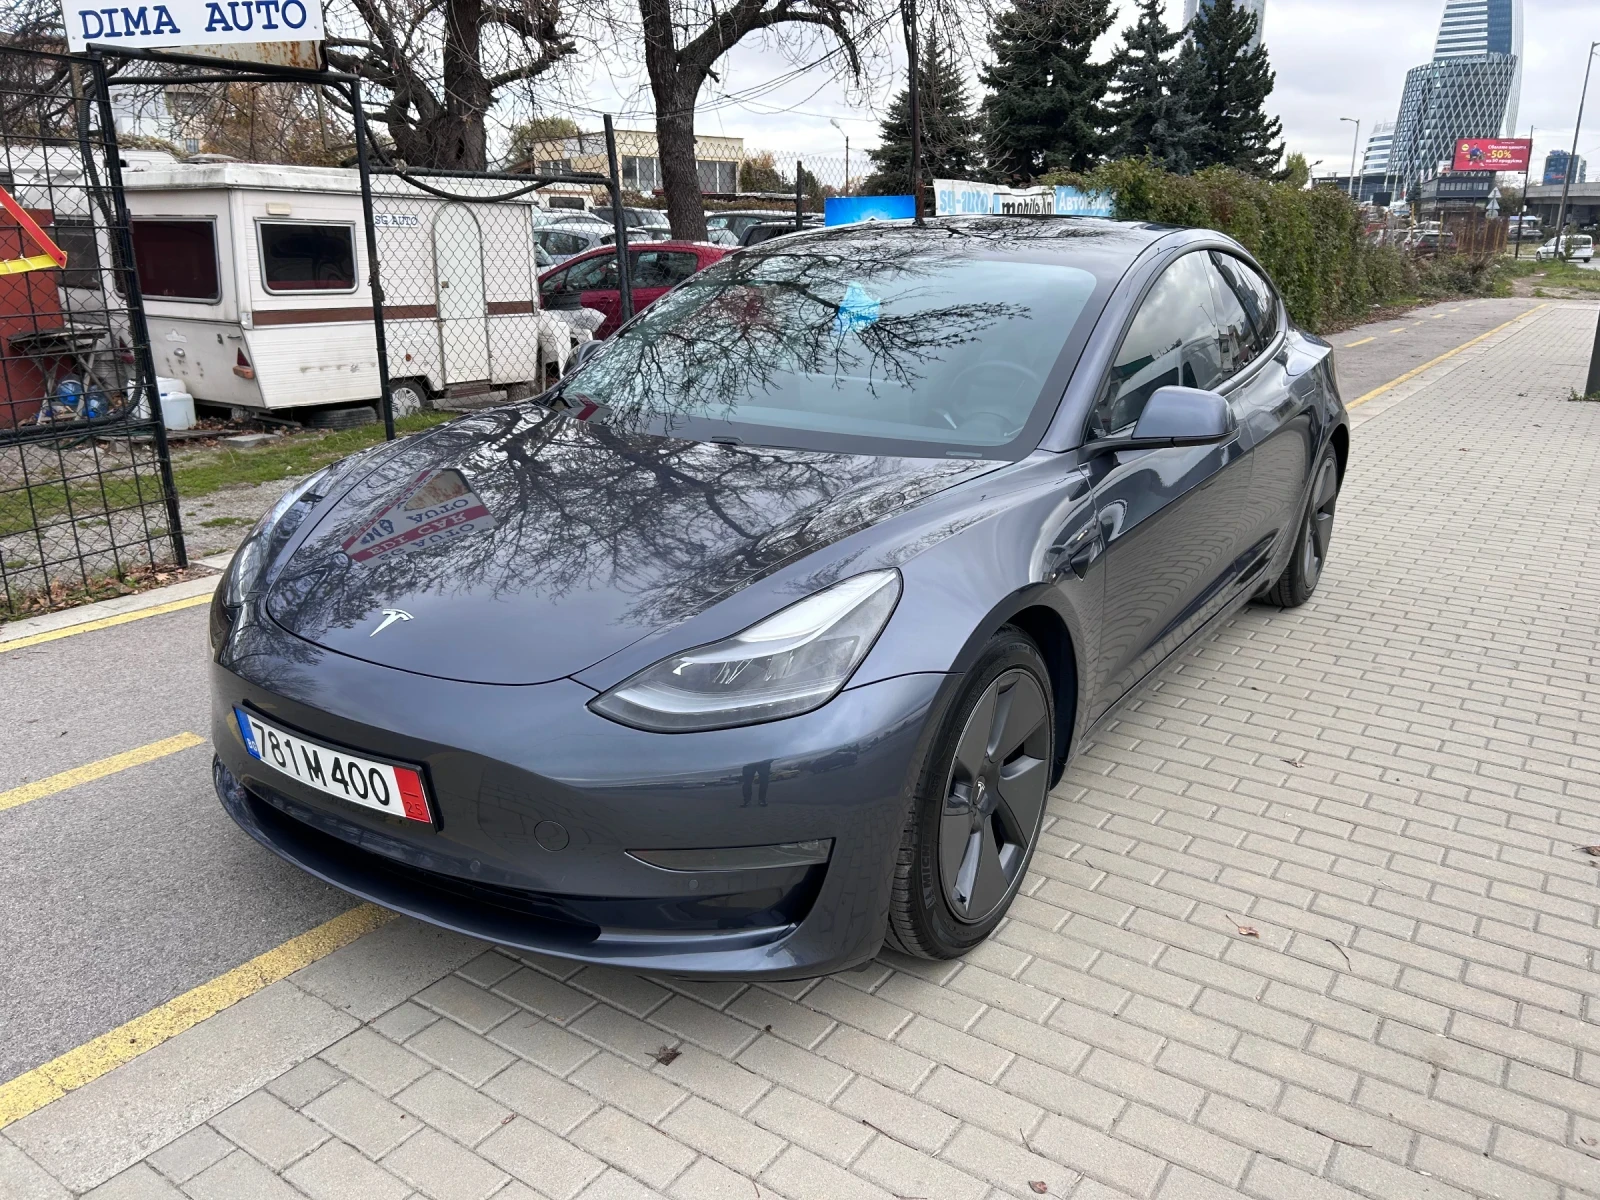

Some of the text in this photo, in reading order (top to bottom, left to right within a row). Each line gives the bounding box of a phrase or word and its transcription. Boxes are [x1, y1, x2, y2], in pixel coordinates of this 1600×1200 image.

[78, 0, 307, 40] DIMA AUTO
[1487, 150, 1512, 158] -50%
[391, 215, 418, 226] AUTO
[405, 801, 423, 816] 25
